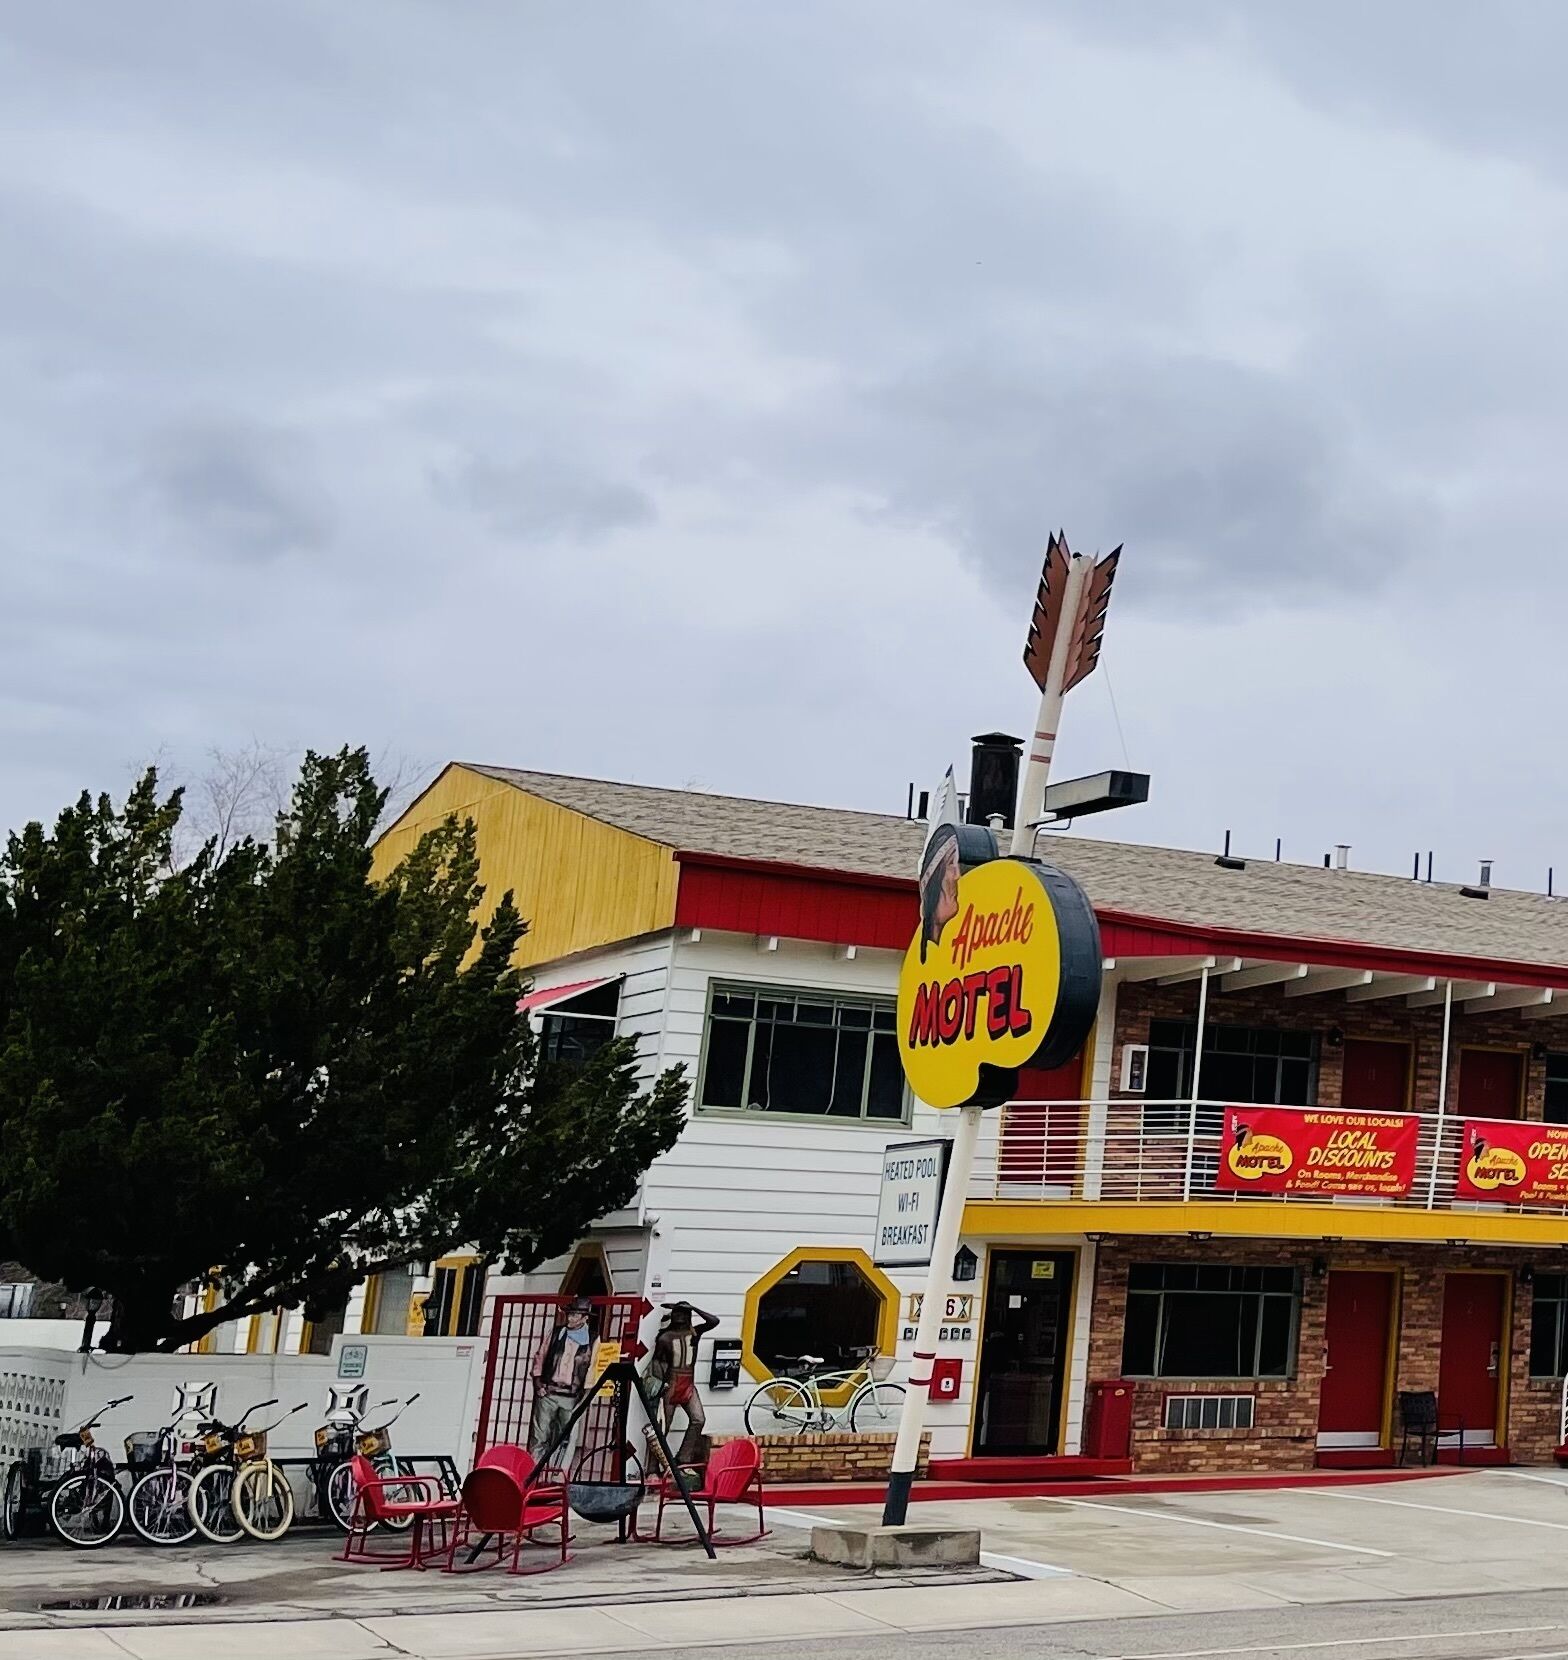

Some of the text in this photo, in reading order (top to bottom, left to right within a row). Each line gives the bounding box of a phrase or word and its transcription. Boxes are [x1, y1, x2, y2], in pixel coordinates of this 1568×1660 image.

[952, 886, 1034, 970] Apache
[908, 963, 1033, 1050] MOTEL
[1304, 1114, 1404, 1128] WE LOVE OUR LOCALS!
[1327, 1129, 1378, 1150] LOCAL
[1546, 1129, 1568, 1140] NOW
[1235, 1154, 1285, 1169] MOTEL
[1306, 1146, 1397, 1169] DISCOUNTS
[885, 1157, 937, 1181] HEATED POOL
[1297, 1169, 1312, 1179] On
[1313, 1169, 1344, 1181] Rooms,
[1474, 1166, 1519, 1181] MOTEL
[1321, 1180, 1347, 1190] Come
[898, 1192, 919, 1213] WI-FI
[881, 1224, 928, 1246] BREAKFAST
